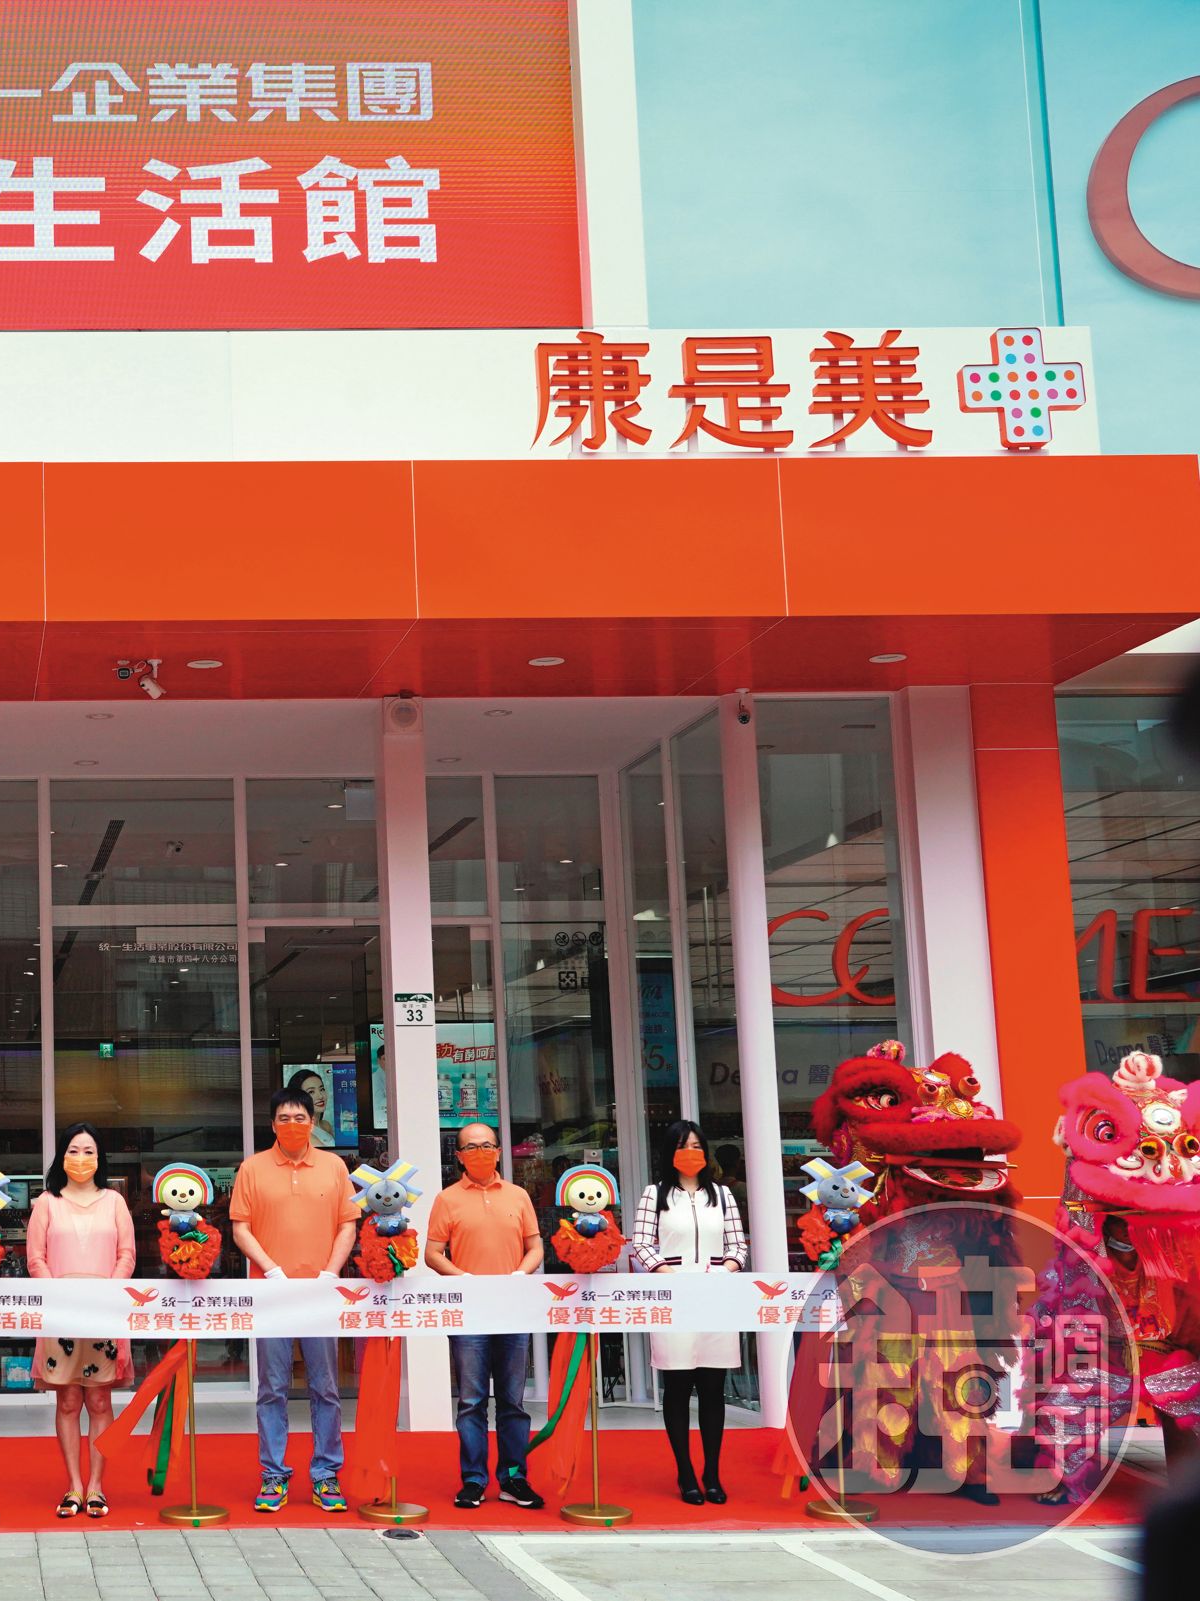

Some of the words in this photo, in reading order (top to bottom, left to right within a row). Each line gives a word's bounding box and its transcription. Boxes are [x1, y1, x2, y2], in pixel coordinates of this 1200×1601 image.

[530, 331, 933, 450] 康是美
[406, 1009, 423, 1022] 33
[709, 1062, 799, 1086] Dea
[161, 1295, 254, 1308] 統一企業集團
[372, 1292, 463, 1305] 統一企業集團
[581, 1289, 672, 1302] 統一企業集團
[791, 1289, 839, 1301] 統一企
[127, 1312, 254, 1332] 優質生活館
[338, 1309, 464, 1330] 優質生活館
[547, 1305, 673, 1326] 優質生活館
